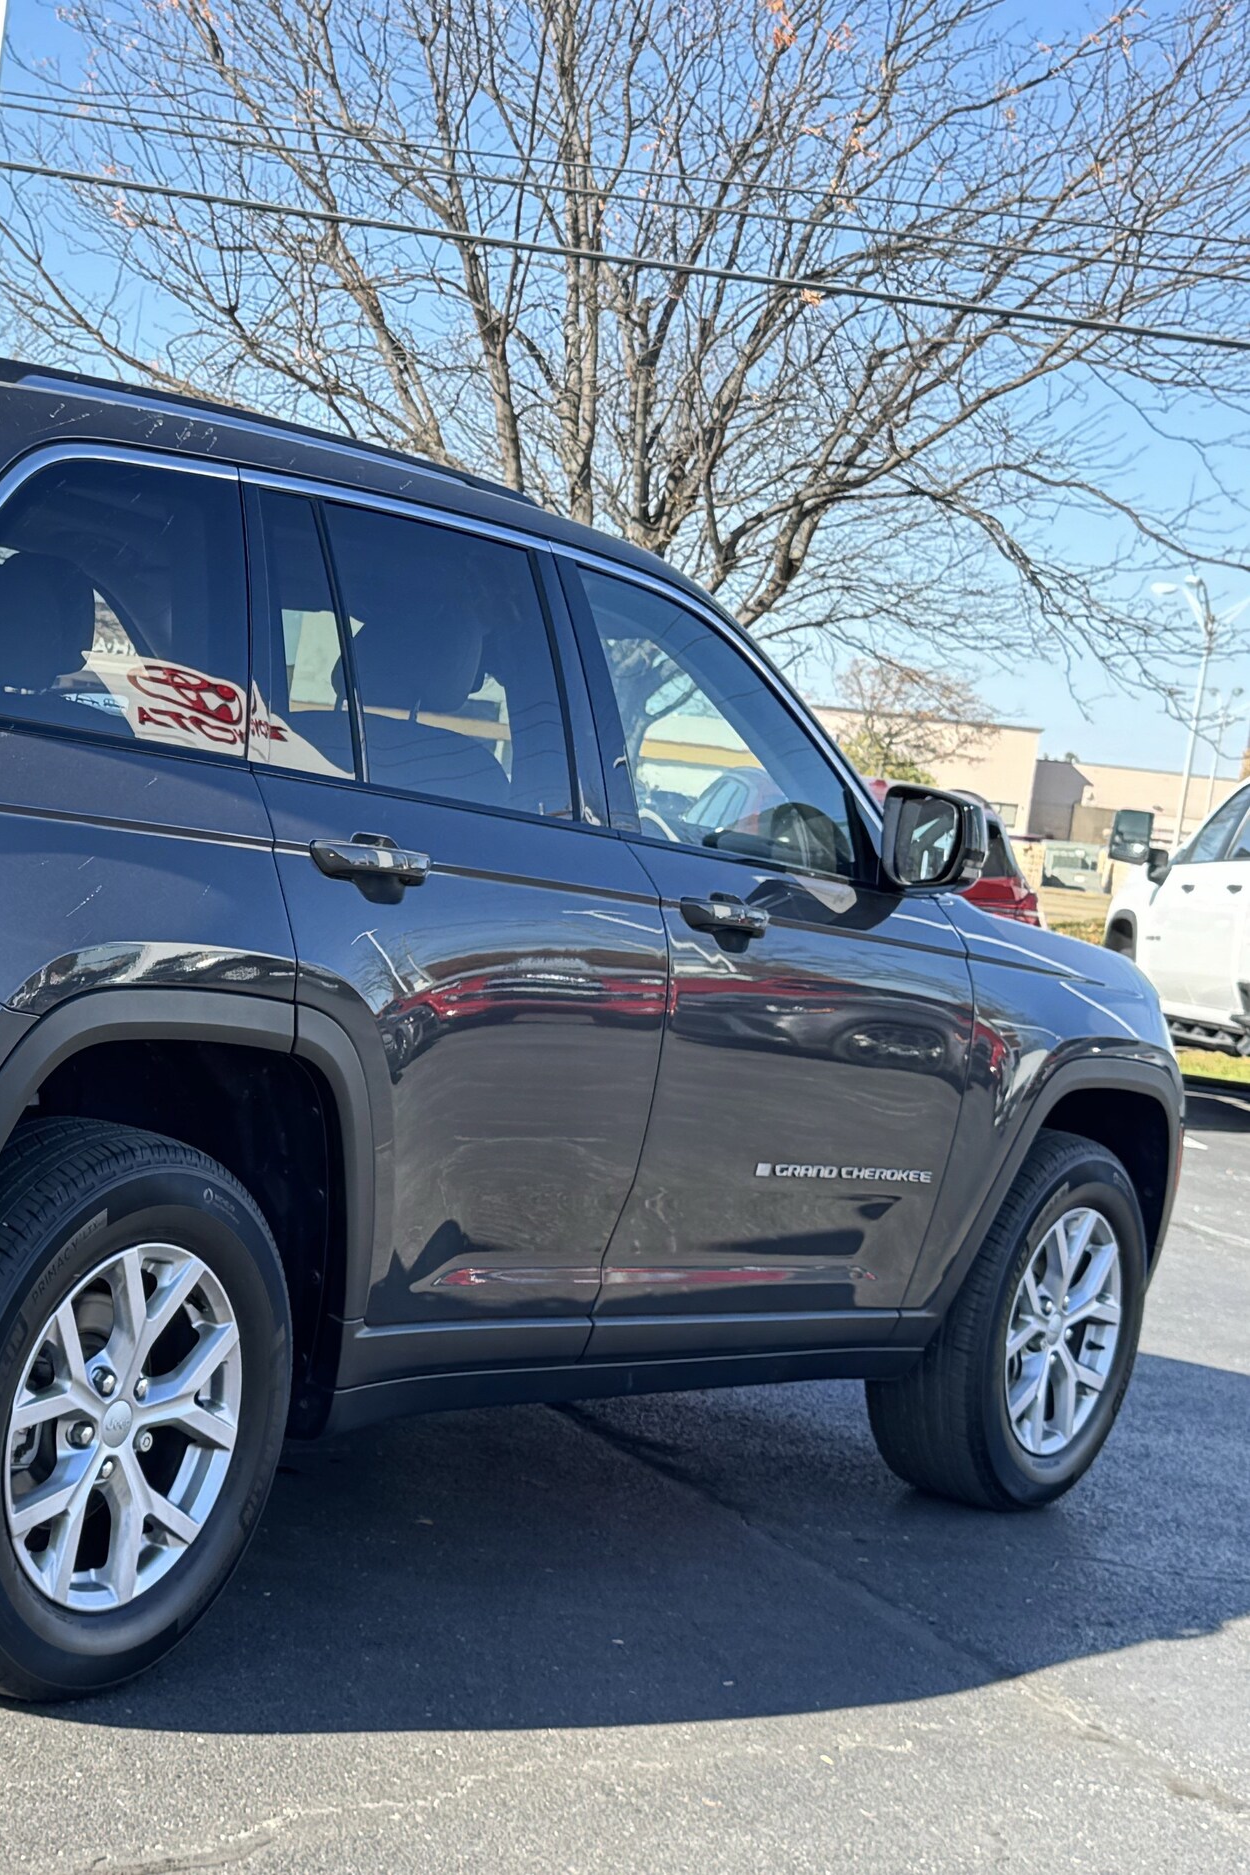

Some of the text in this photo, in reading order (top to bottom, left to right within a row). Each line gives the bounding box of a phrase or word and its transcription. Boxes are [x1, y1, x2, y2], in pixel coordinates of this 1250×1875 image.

[774, 1163, 933, 1184] GRAND CHEROKEE
[31, 1238, 79, 1304] PRIMACY
